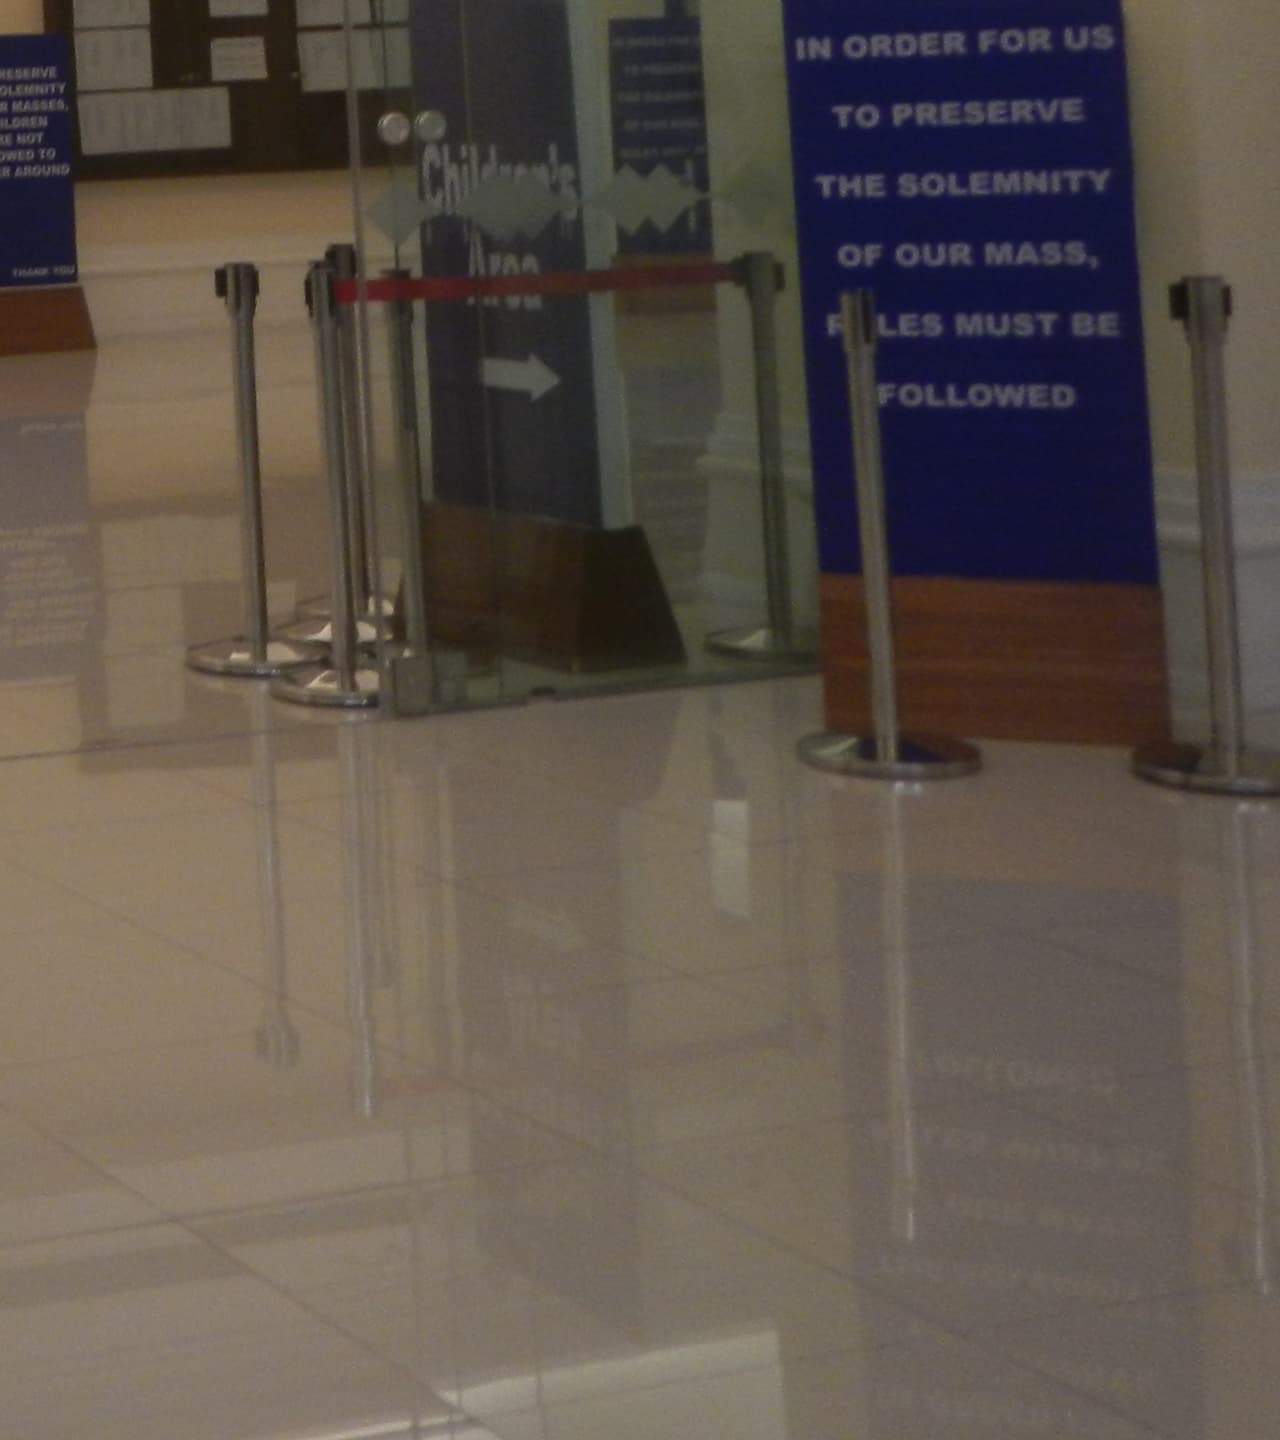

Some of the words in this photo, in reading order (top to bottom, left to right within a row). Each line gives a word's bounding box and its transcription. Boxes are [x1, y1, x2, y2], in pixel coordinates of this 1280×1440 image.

[796, 38, 831, 60] IN
[843, 32, 966, 58] ORDER
[978, 28, 1051, 53] FOR
[1064, 25, 1115, 50] US
[832, 104, 880, 128] TO
[892, 98, 1084, 126] PRESERVE
[16, 131, 44, 145] NOT
[37, 147, 57, 161] TO
[14, 163, 71, 177] AROUND
[816, 175, 885, 197] THE
[898, 170, 1110, 197] SOLEMNITY
[838, 244, 882, 267] OF
[895, 243, 972, 266] OUR
[985, 241, 1098, 268] MASS,
[827, 312, 943, 339] RLES
[955, 311, 1058, 337] MUST
[1071, 310, 1120, 336] BE
[877, 382, 1076, 410] FOLLOWED
